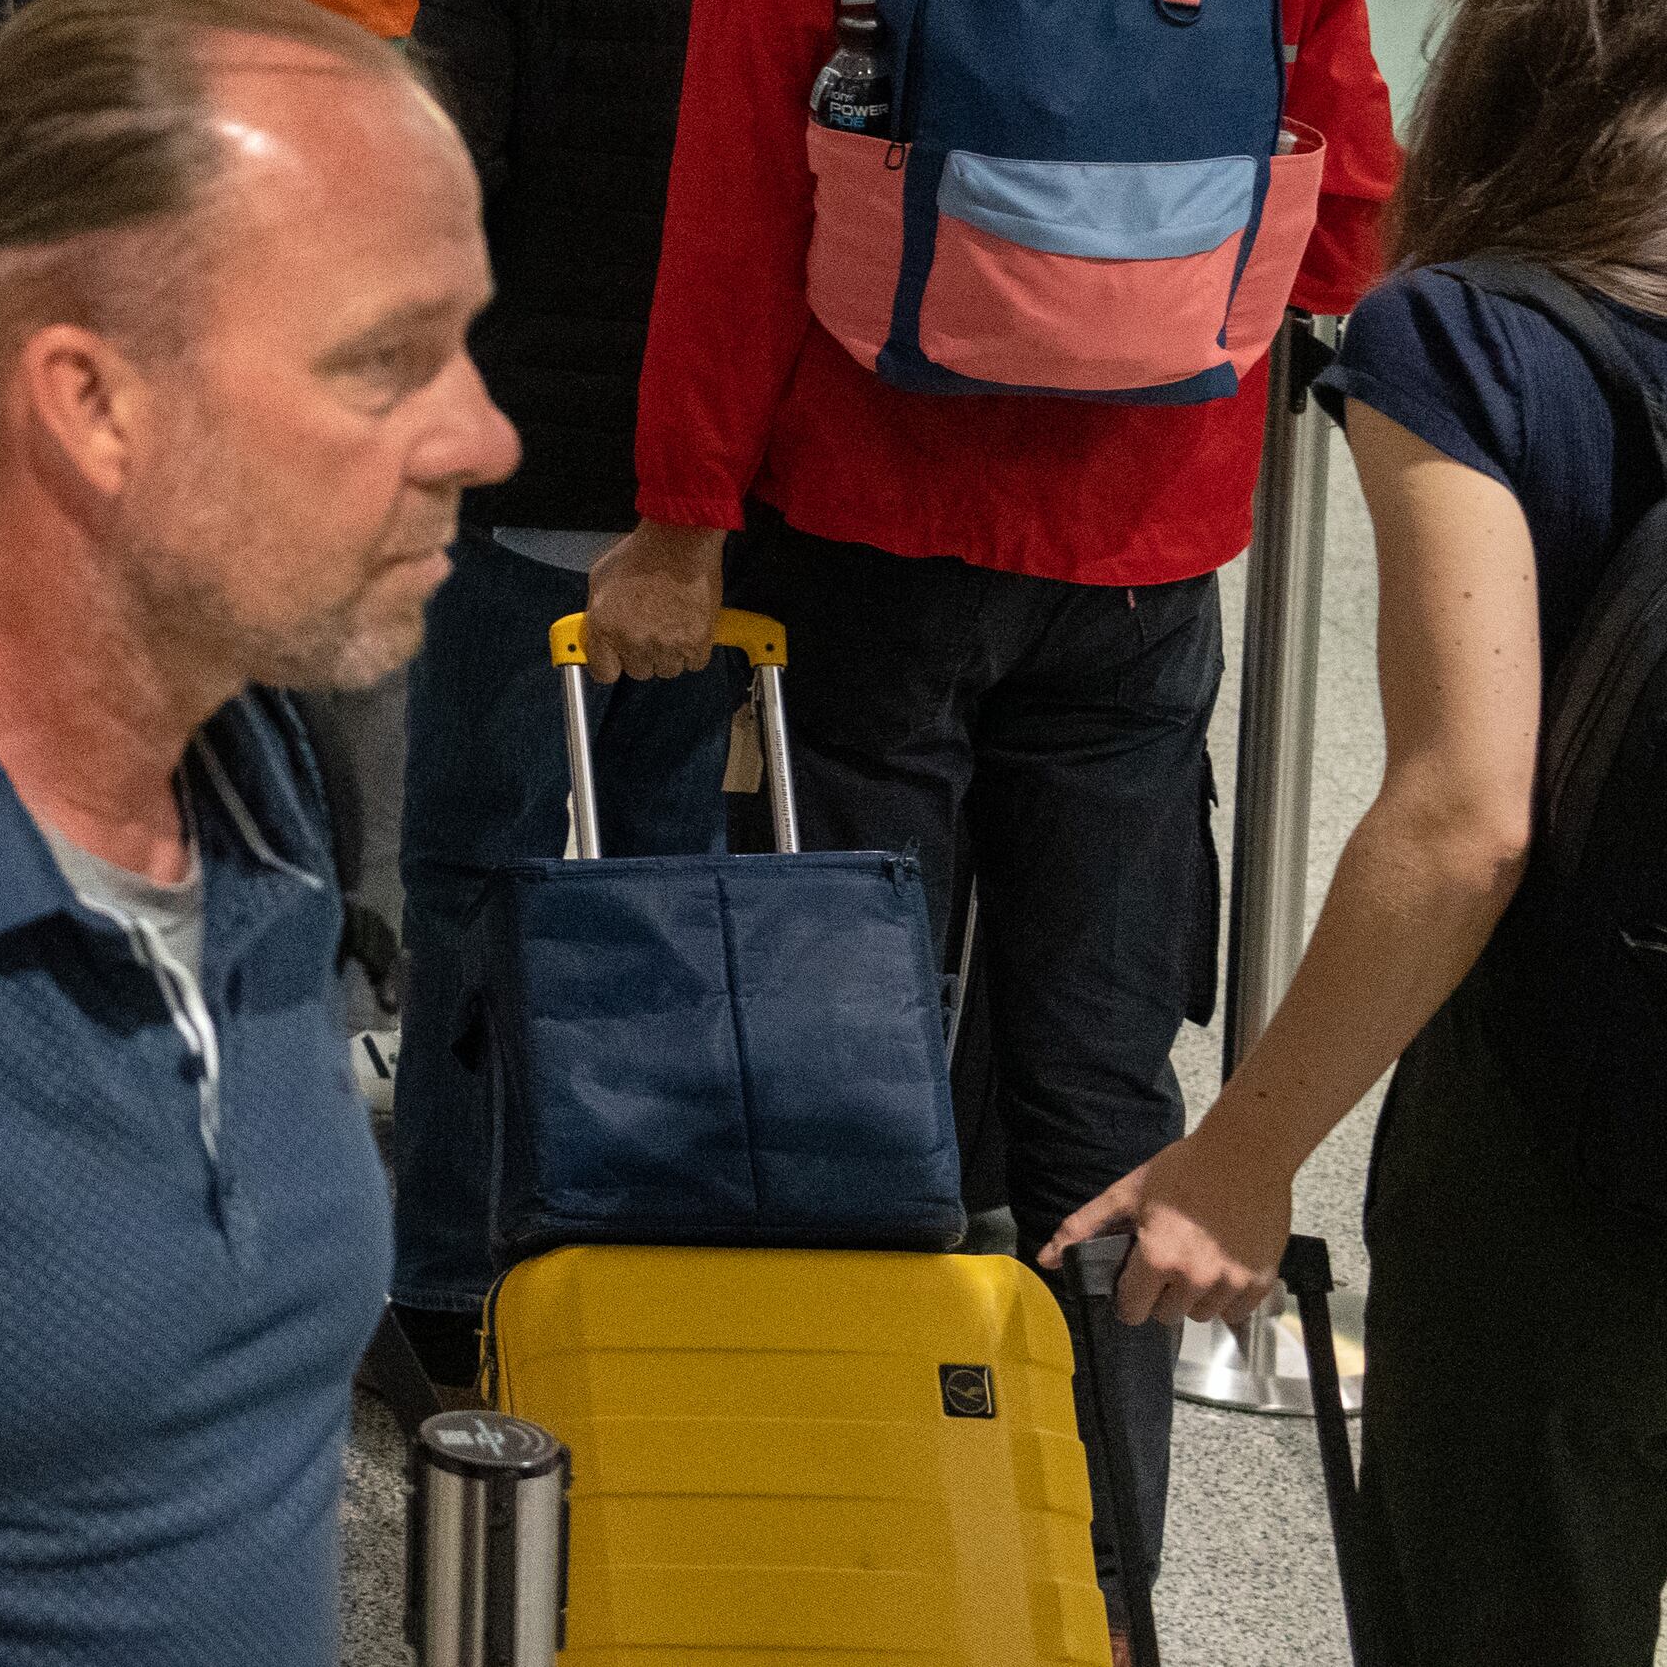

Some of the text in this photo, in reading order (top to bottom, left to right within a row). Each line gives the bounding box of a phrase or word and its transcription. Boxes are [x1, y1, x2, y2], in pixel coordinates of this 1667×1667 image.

[830, 102, 890, 116] POWER
[774, 729, 784, 773] Collection
[779, 775, 789, 816] Universal
